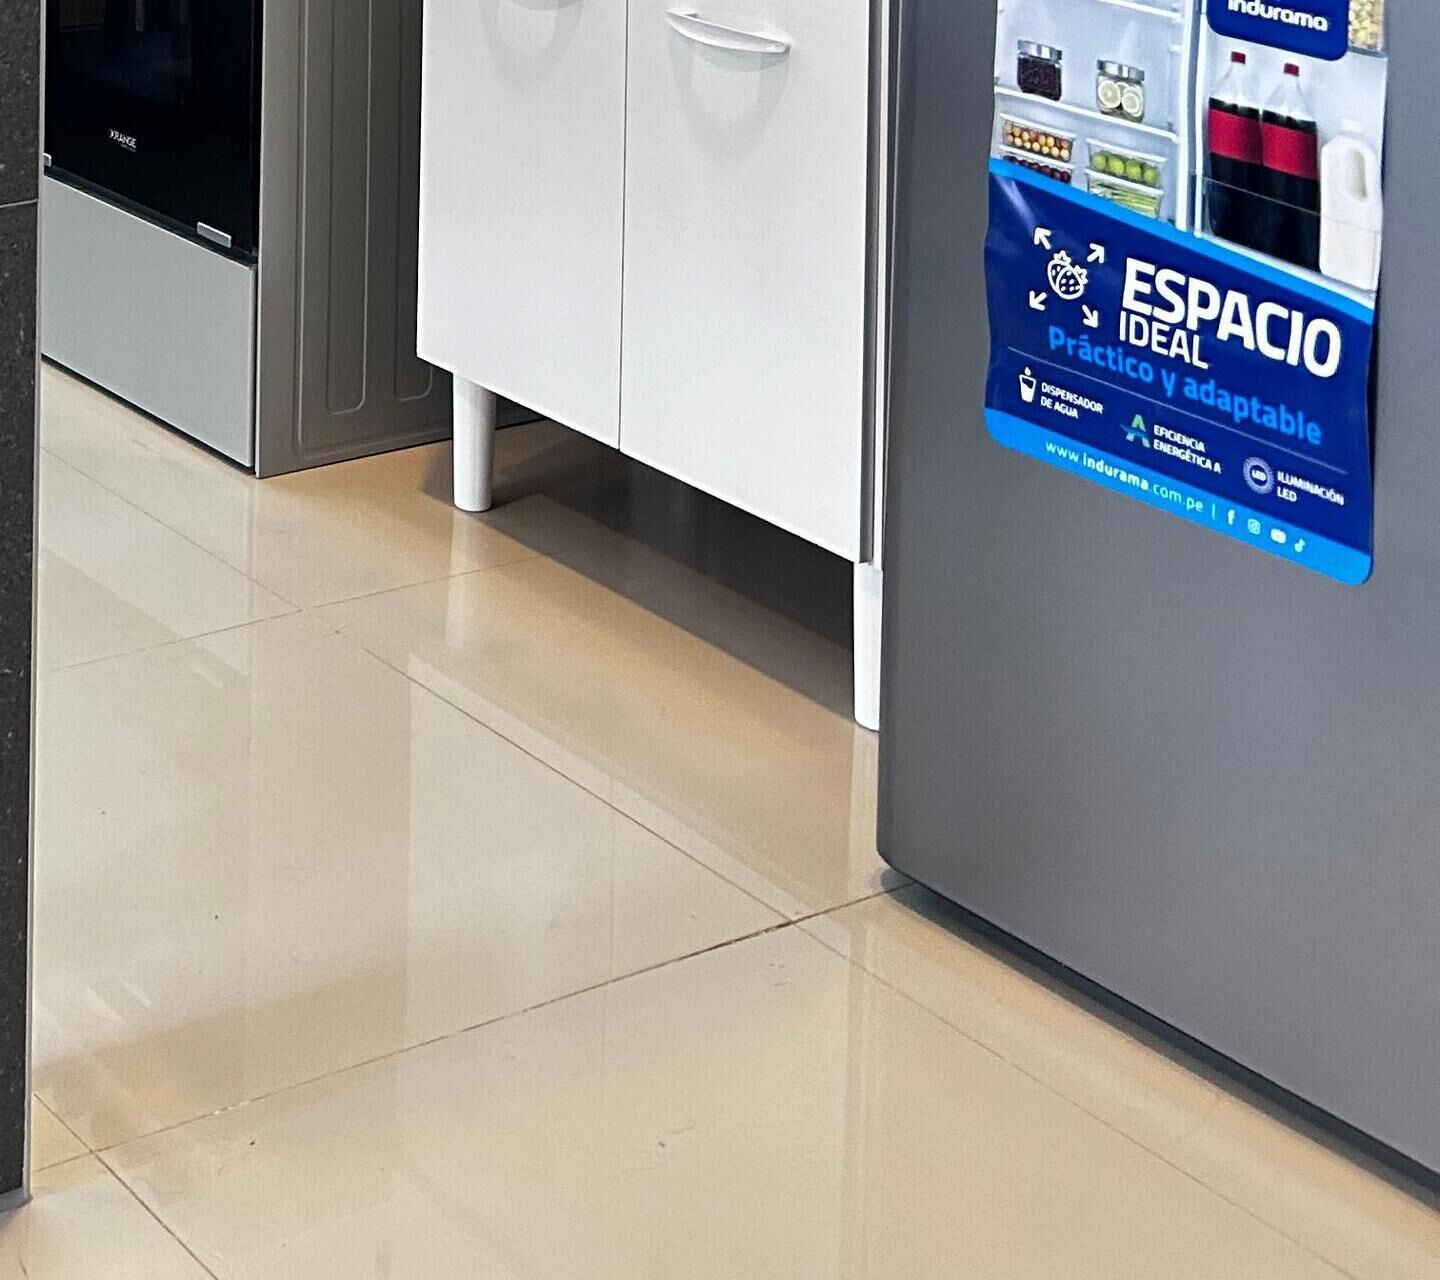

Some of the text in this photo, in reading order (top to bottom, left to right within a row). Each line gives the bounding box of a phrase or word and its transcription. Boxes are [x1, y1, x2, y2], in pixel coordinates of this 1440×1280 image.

[1122, 256, 1342, 378] ESPACIO
[1119, 310, 1210, 370] IDEAL
[1041, 382, 1104, 414] DISPENSADOR
[1048, 325, 1323, 446] Práctico y adaptable
[1040, 395, 1079, 419] DE AGUA
[1153, 424, 1206, 453] EFICIENCIA
[1153, 438, 1222, 474] ENERGÉTICA A
[1045, 441, 1204, 513] www.indurama.com.pe
[1277, 470, 1345, 507] ILUMINACIÓN
[1277, 486, 1298, 502] LED
